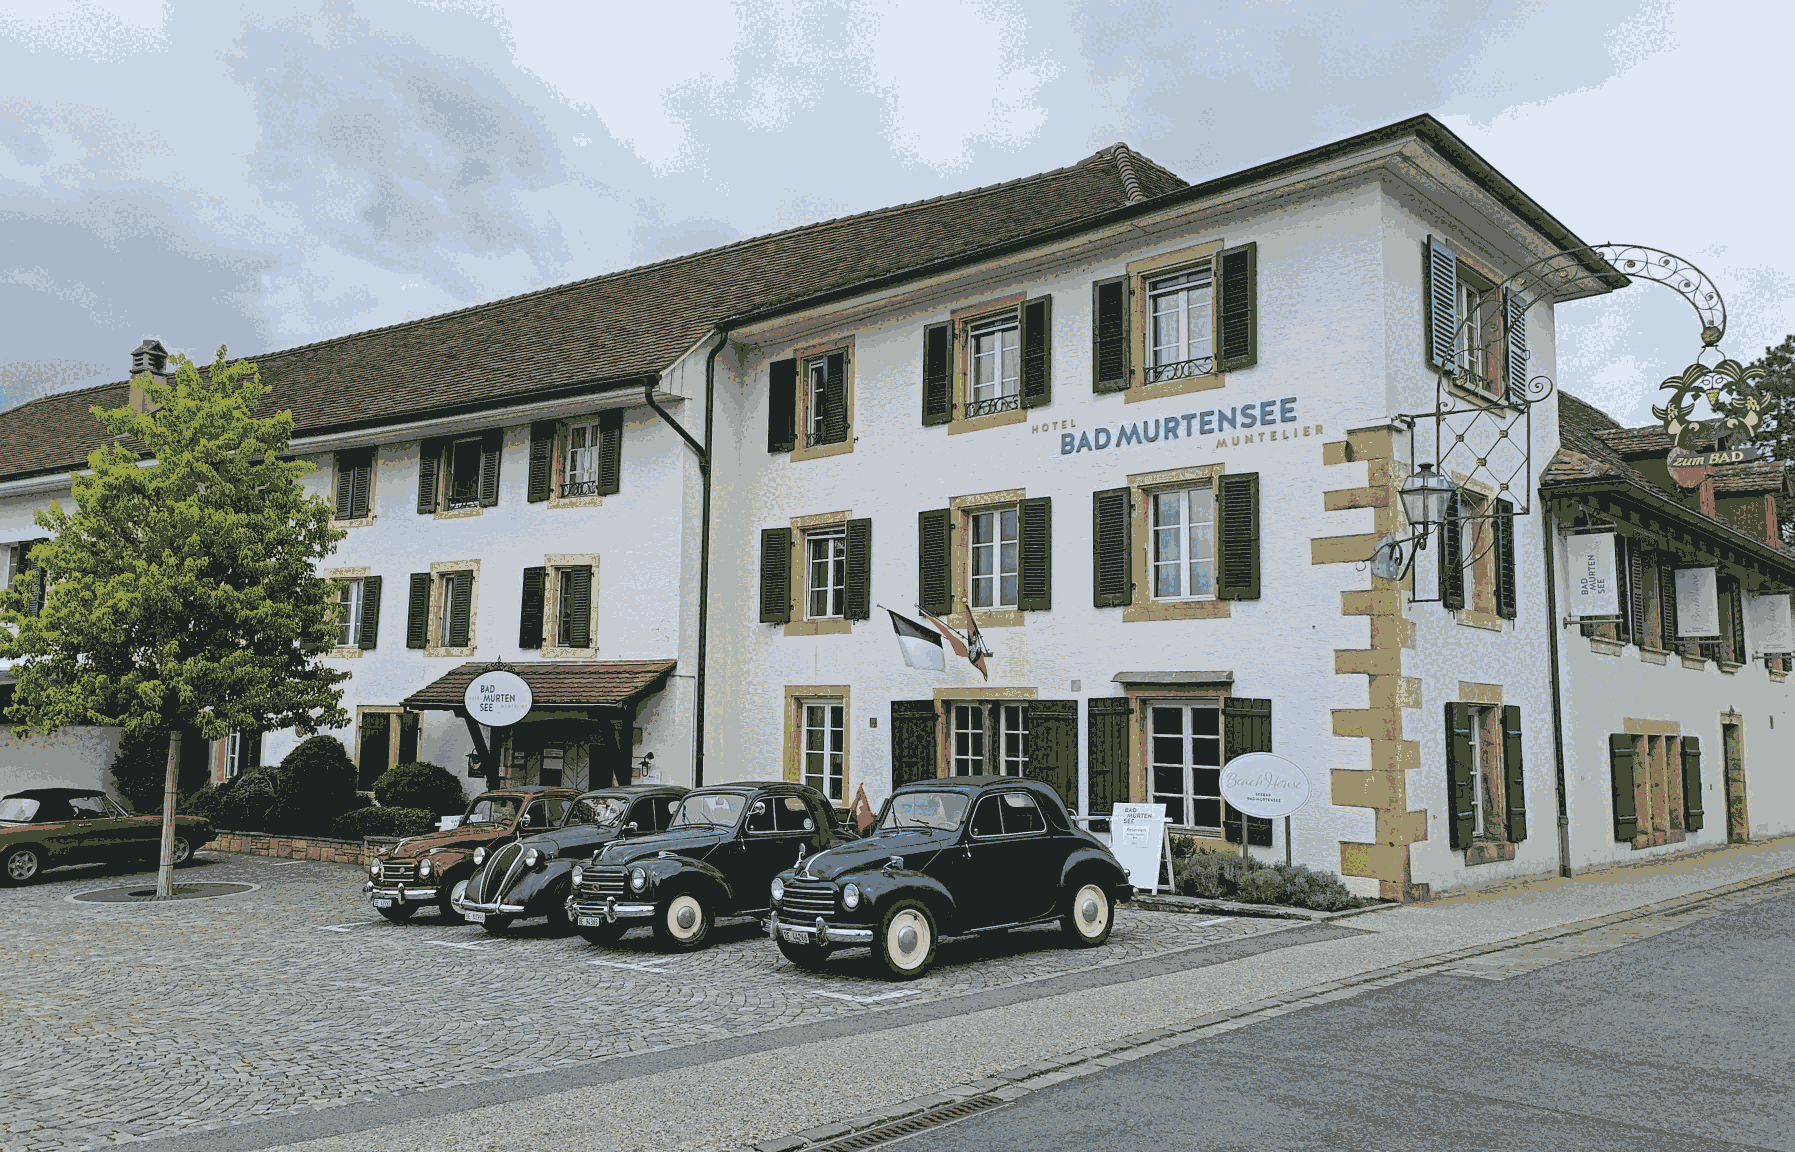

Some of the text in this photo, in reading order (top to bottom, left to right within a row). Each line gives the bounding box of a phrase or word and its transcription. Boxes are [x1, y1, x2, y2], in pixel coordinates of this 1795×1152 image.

[1031, 418, 1077, 435] HOTEL
[1060, 396, 1298, 455] BAD MURTENSEE
[1215, 423, 1325, 450] MUNTELIER
[1708, 450, 1744, 465] BAD
[1587, 554, 1597, 591] MURTEN
[1580, 577, 1589, 596] BAD
[1596, 578, 1606, 595] SEE
[480, 684, 496, 694] BAD
[482, 693, 516, 703] MURTEN
[479, 703, 494, 712] SEE
[1225, 771, 1302, 790] Beach House
